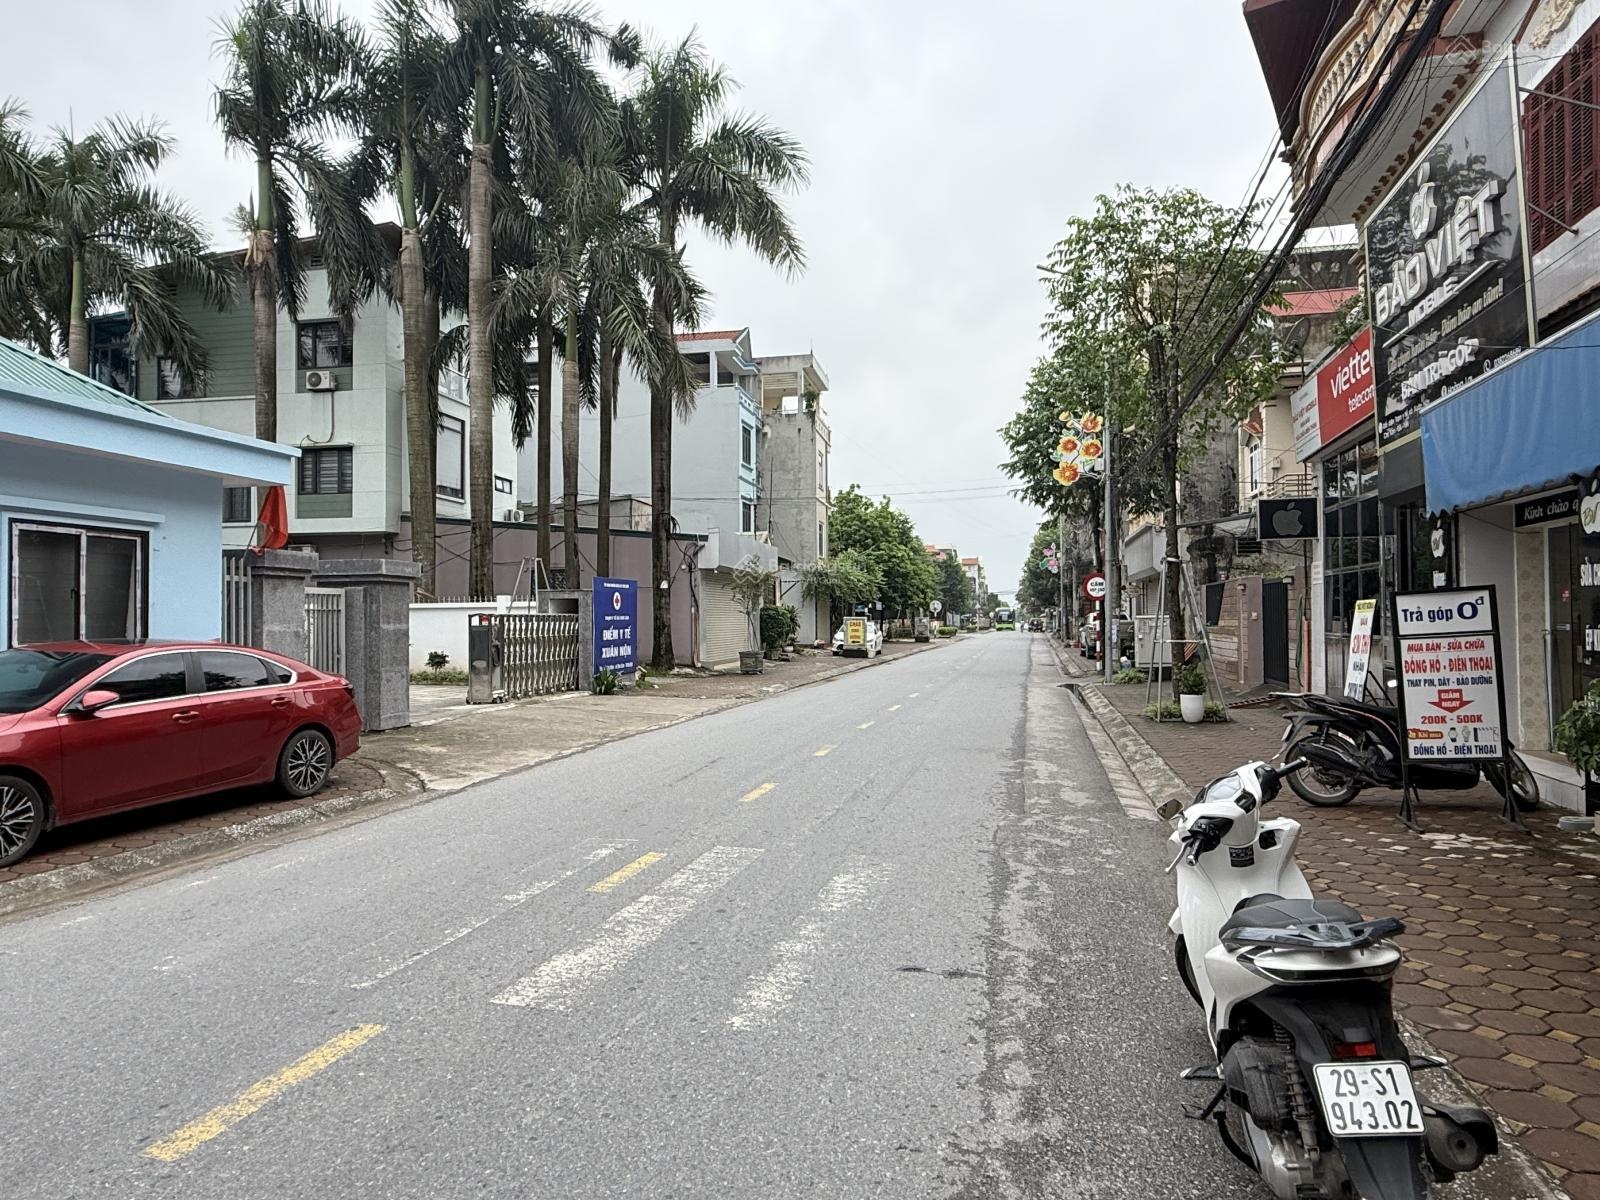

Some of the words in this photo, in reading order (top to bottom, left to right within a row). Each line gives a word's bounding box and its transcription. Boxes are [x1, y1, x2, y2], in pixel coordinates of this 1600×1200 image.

[1425, 180, 1500, 279] VIỆT
[1408, 276, 1460, 328] MOBILE
[1330, 348, 1370, 399] viette
[1547, 499, 1569, 515] chào
[1401, 605, 1423, 622] Trả
[1427, 606, 1454, 623] góp
[619, 629, 624, 640] Y
[624, 625, 631, 639] TẾ
[602, 644, 618, 658] XUÂN
[1407, 643, 1423, 652] MUA
[1425, 640, 1442, 652] BÁN
[1447, 638, 1462, 651] SỬA
[1464, 638, 1485, 650] CHỮA
[1469, 656, 1493, 674] THOẠI
[1407, 679, 1422, 688] THAY
[1423, 679, 1437, 688] PIN,
[1438, 676, 1450, 687] DÂY
[1456, 675, 1469, 686] BẢO
[1470, 674, 1493, 686] DƯỠNG
[1421, 715, 1447, 725] 200K
[1456, 714, 1483, 724] 500K
[1413, 743, 1435, 755] ĐỒNG
[1436, 742, 1447, 756] HỒ
[1454, 743, 1472, 757] ĐIỆN
[1474, 744, 1497, 757] THOẠI
[1329, 1067, 1400, 1098] 29-S1
[1331, 1100, 1419, 1131] 943.02
